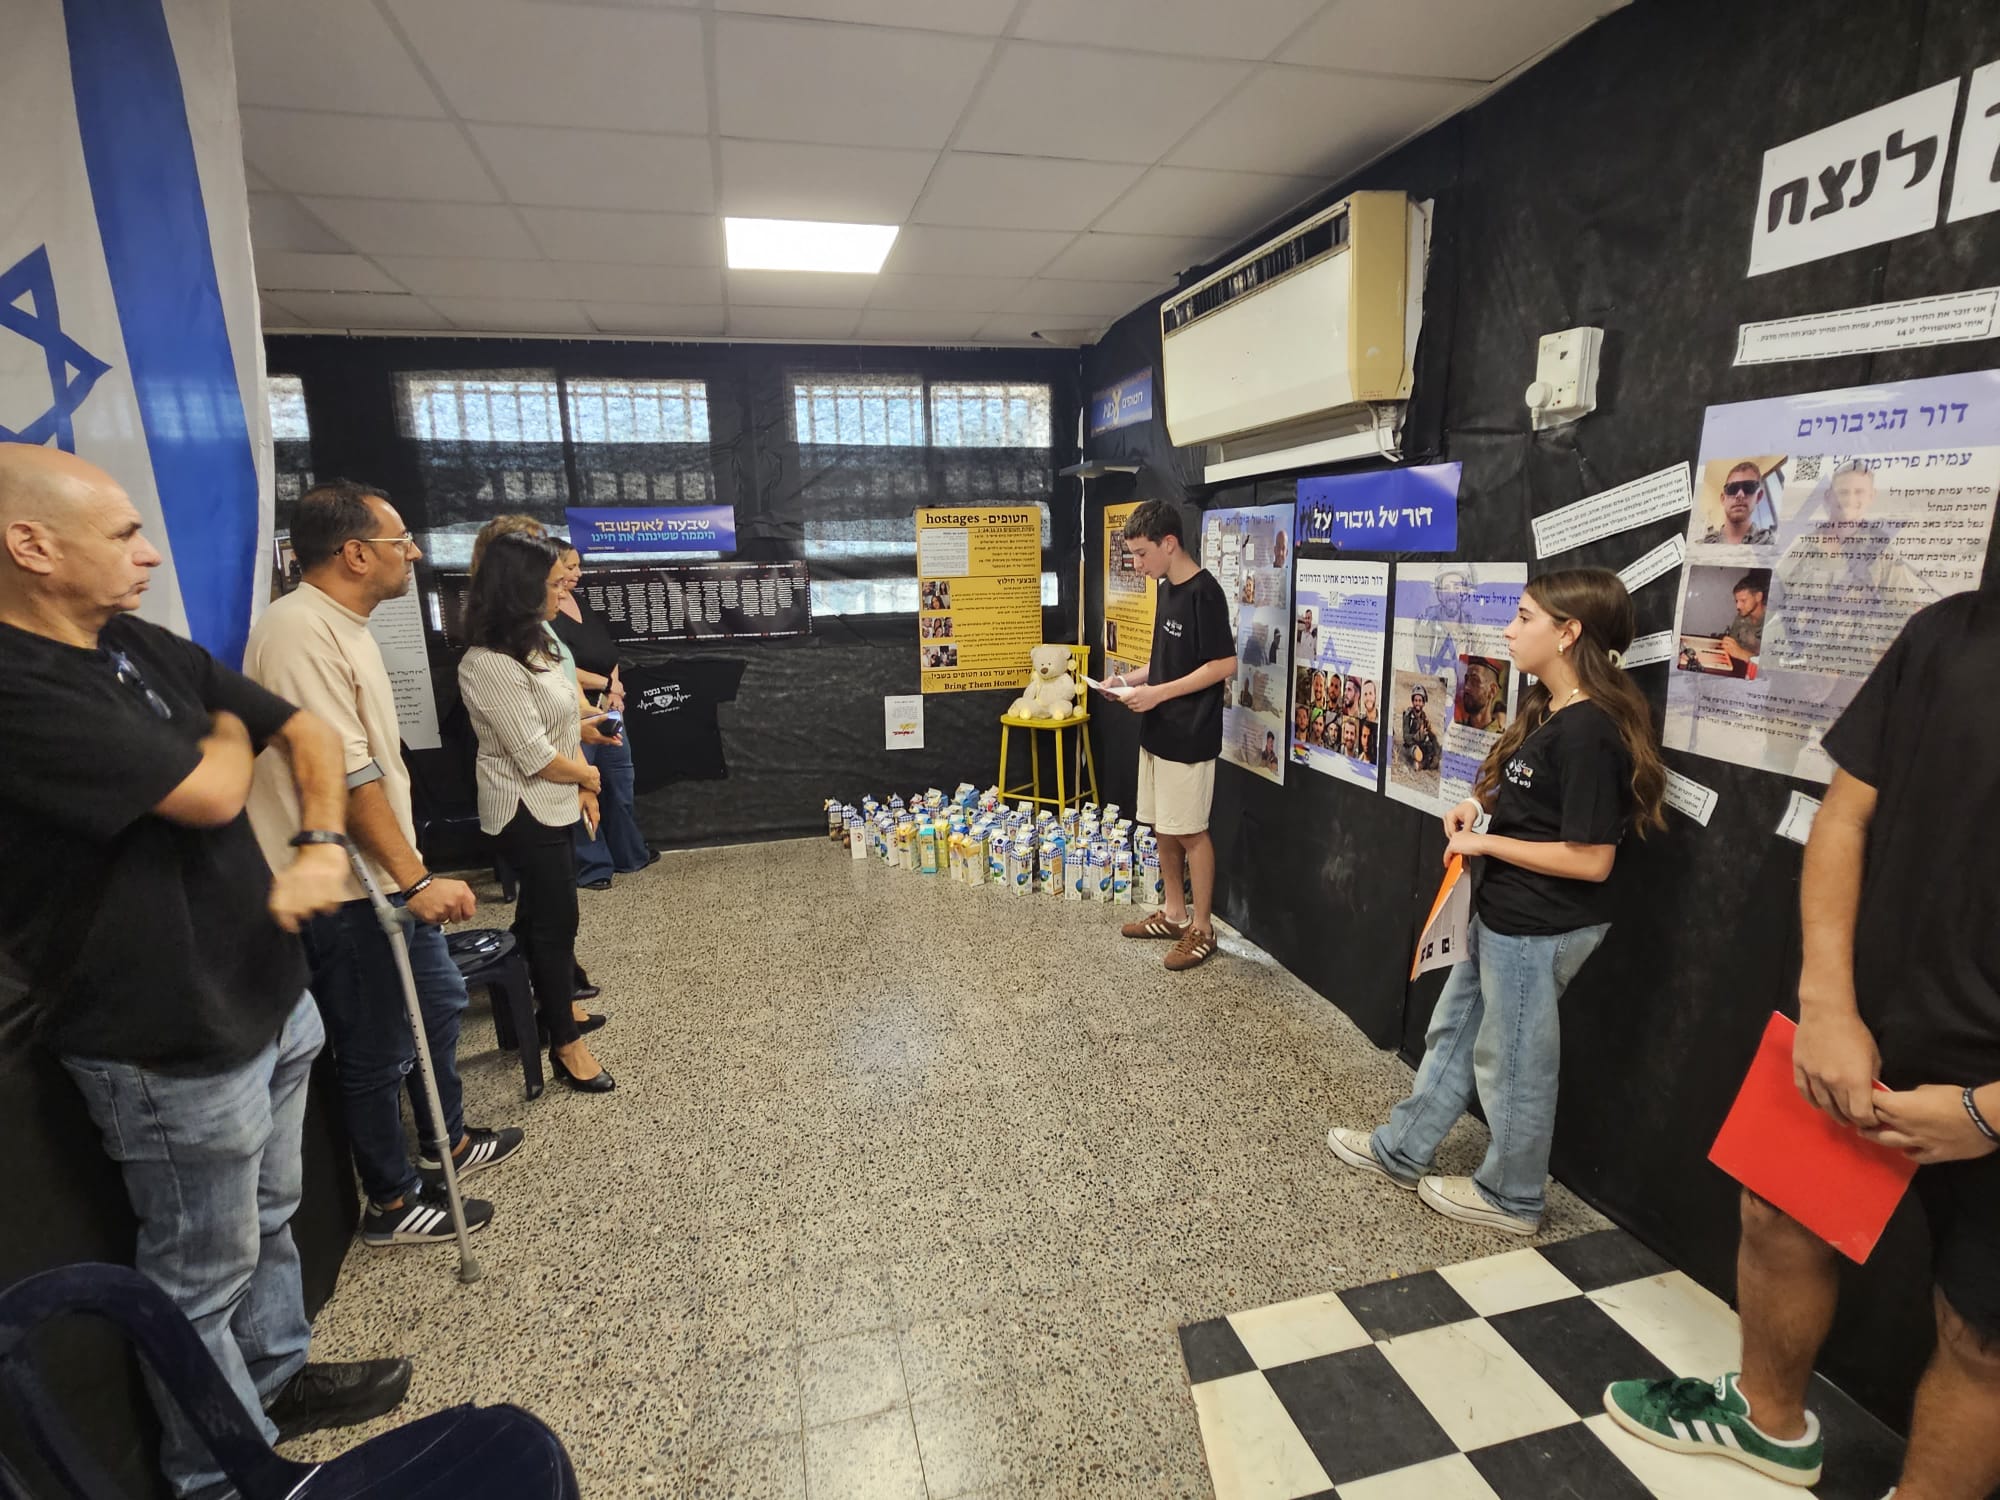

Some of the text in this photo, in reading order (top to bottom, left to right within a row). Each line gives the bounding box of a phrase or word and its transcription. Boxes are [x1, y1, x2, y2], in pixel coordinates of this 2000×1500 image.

[1767, 129, 1939, 234] לנצח
[1973, 305, 1987, 313] אני
[1897, 316, 1909, 324] של
[1797, 403, 1969, 437] דור הגיבורים
[1864, 456, 1921, 474] פרידמן
[1926, 452, 1972, 468] עמית
[1904, 488, 1936, 498] פרידמן
[1938, 487, 1963, 495] עמית
[1955, 503, 1988, 511] חטיבת
[926, 513, 980, 526] hostages
[1313, 505, 1433, 531] דור של גיבורי על
[595, 518, 710, 535] שבעה לאוקטובר
[591, 530, 716, 543] היממה ששינתה את חיינו
[1928, 537, 1953, 545] עמית
[944, 679, 1020, 691] Bring Them Home!
